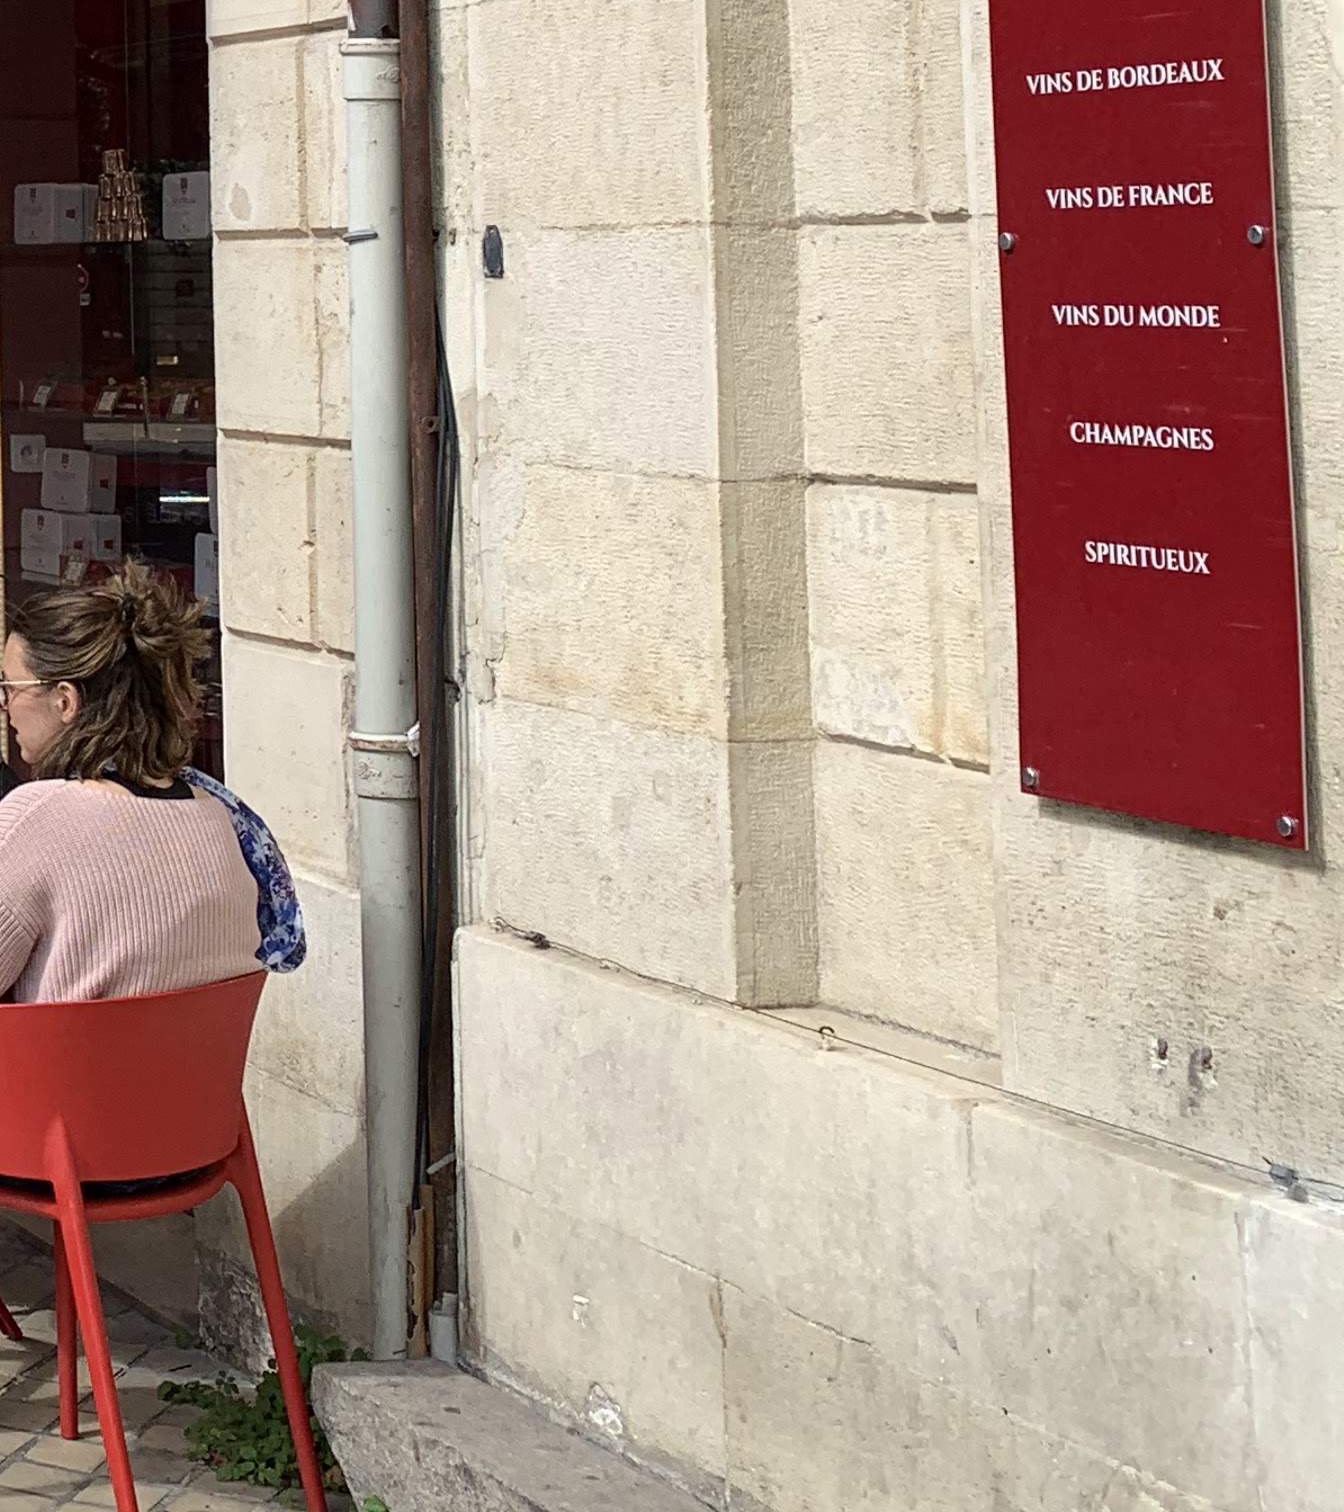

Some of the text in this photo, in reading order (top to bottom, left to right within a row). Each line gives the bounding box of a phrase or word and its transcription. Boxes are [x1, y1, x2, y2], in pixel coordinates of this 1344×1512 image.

[1026, 58, 1225, 96] VINS DE BORDEAUX
[1046, 182, 1214, 211] VINS DE FRANCE
[1052, 304, 1221, 329] VINS DU MONDE
[1070, 421, 1215, 452] CHAMPAGNES
[1084, 540, 1211, 576] SPIRITUEUX
